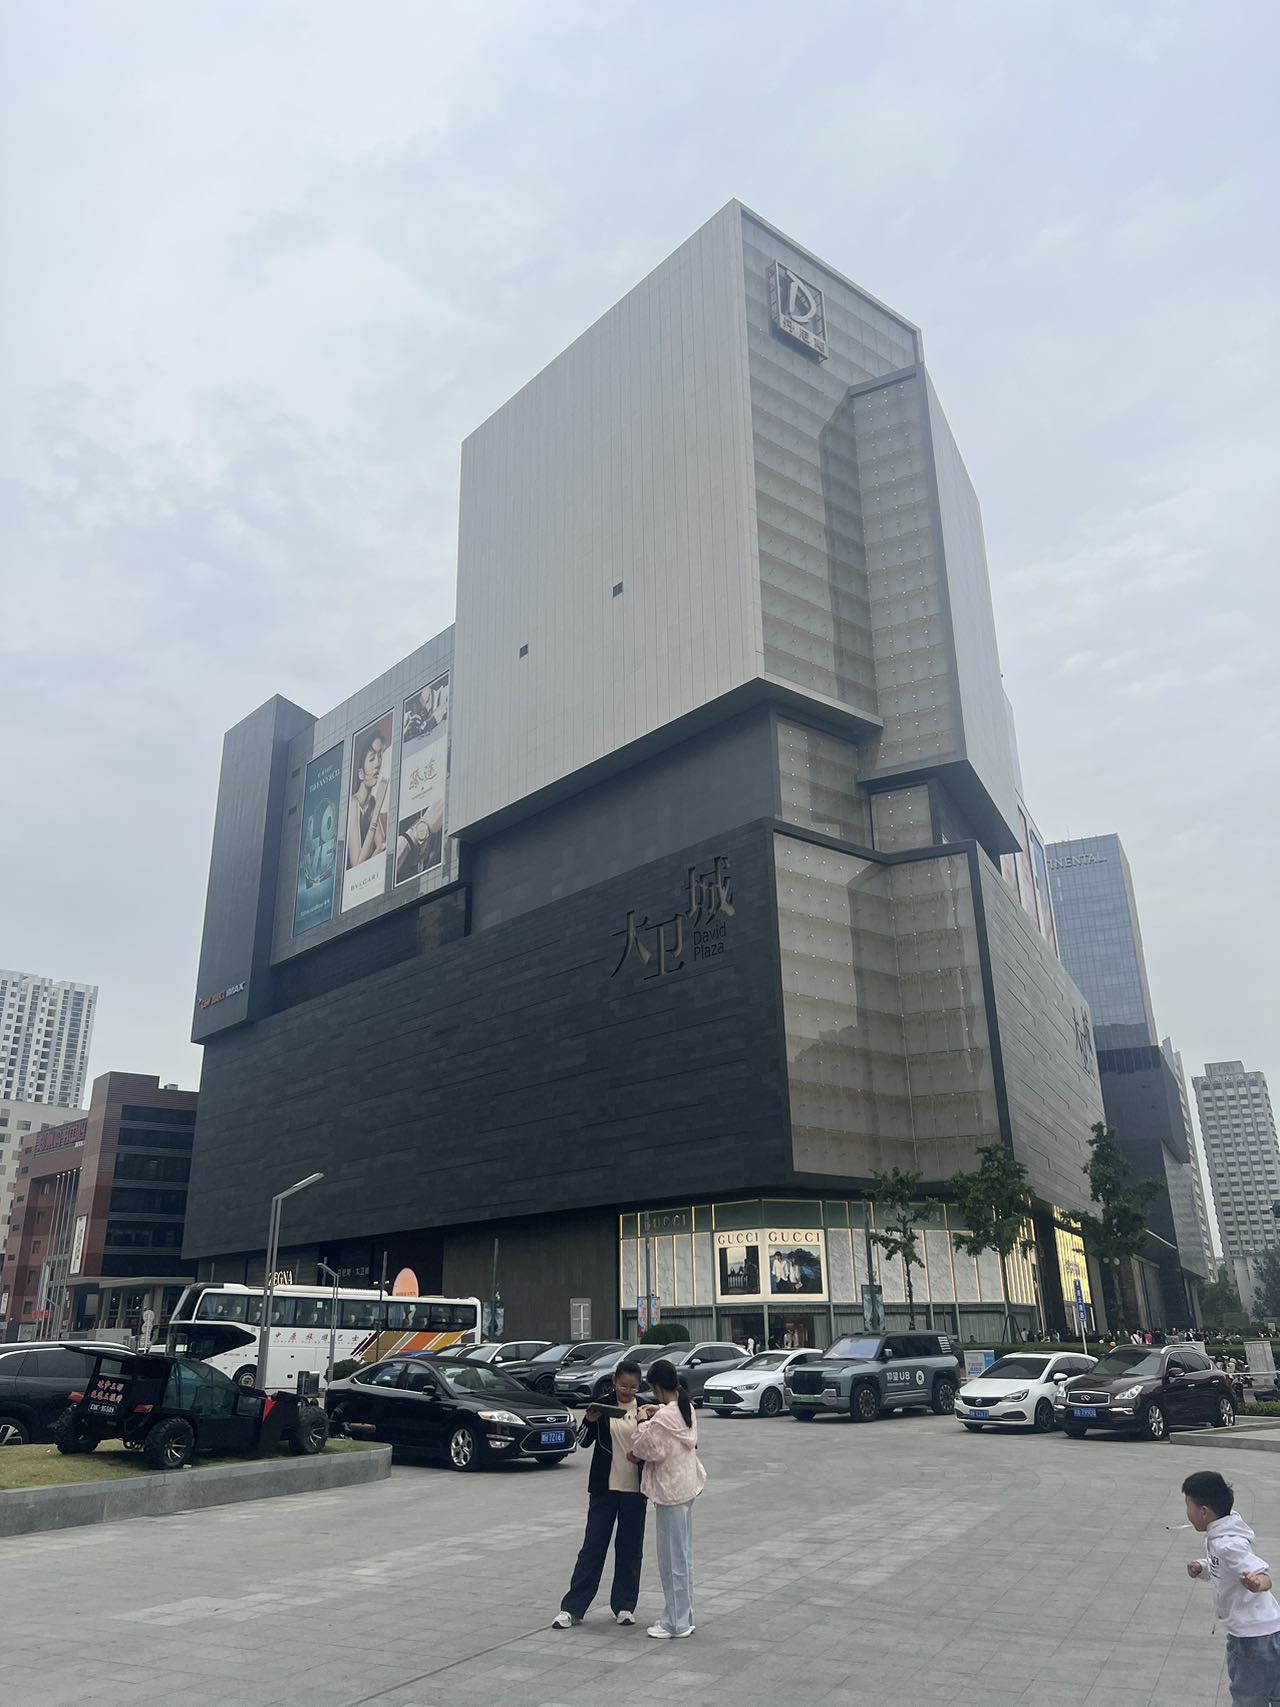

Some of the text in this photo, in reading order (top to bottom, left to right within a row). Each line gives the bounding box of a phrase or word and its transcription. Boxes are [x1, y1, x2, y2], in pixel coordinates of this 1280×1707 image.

[610, 855, 736, 981] 大卫城
[693, 921, 727, 946] David
[693, 941, 725, 962] Plaza
[645, 1213, 687, 1230] UCCI
[717, 1231, 821, 1245] GUCCI GUCCI
